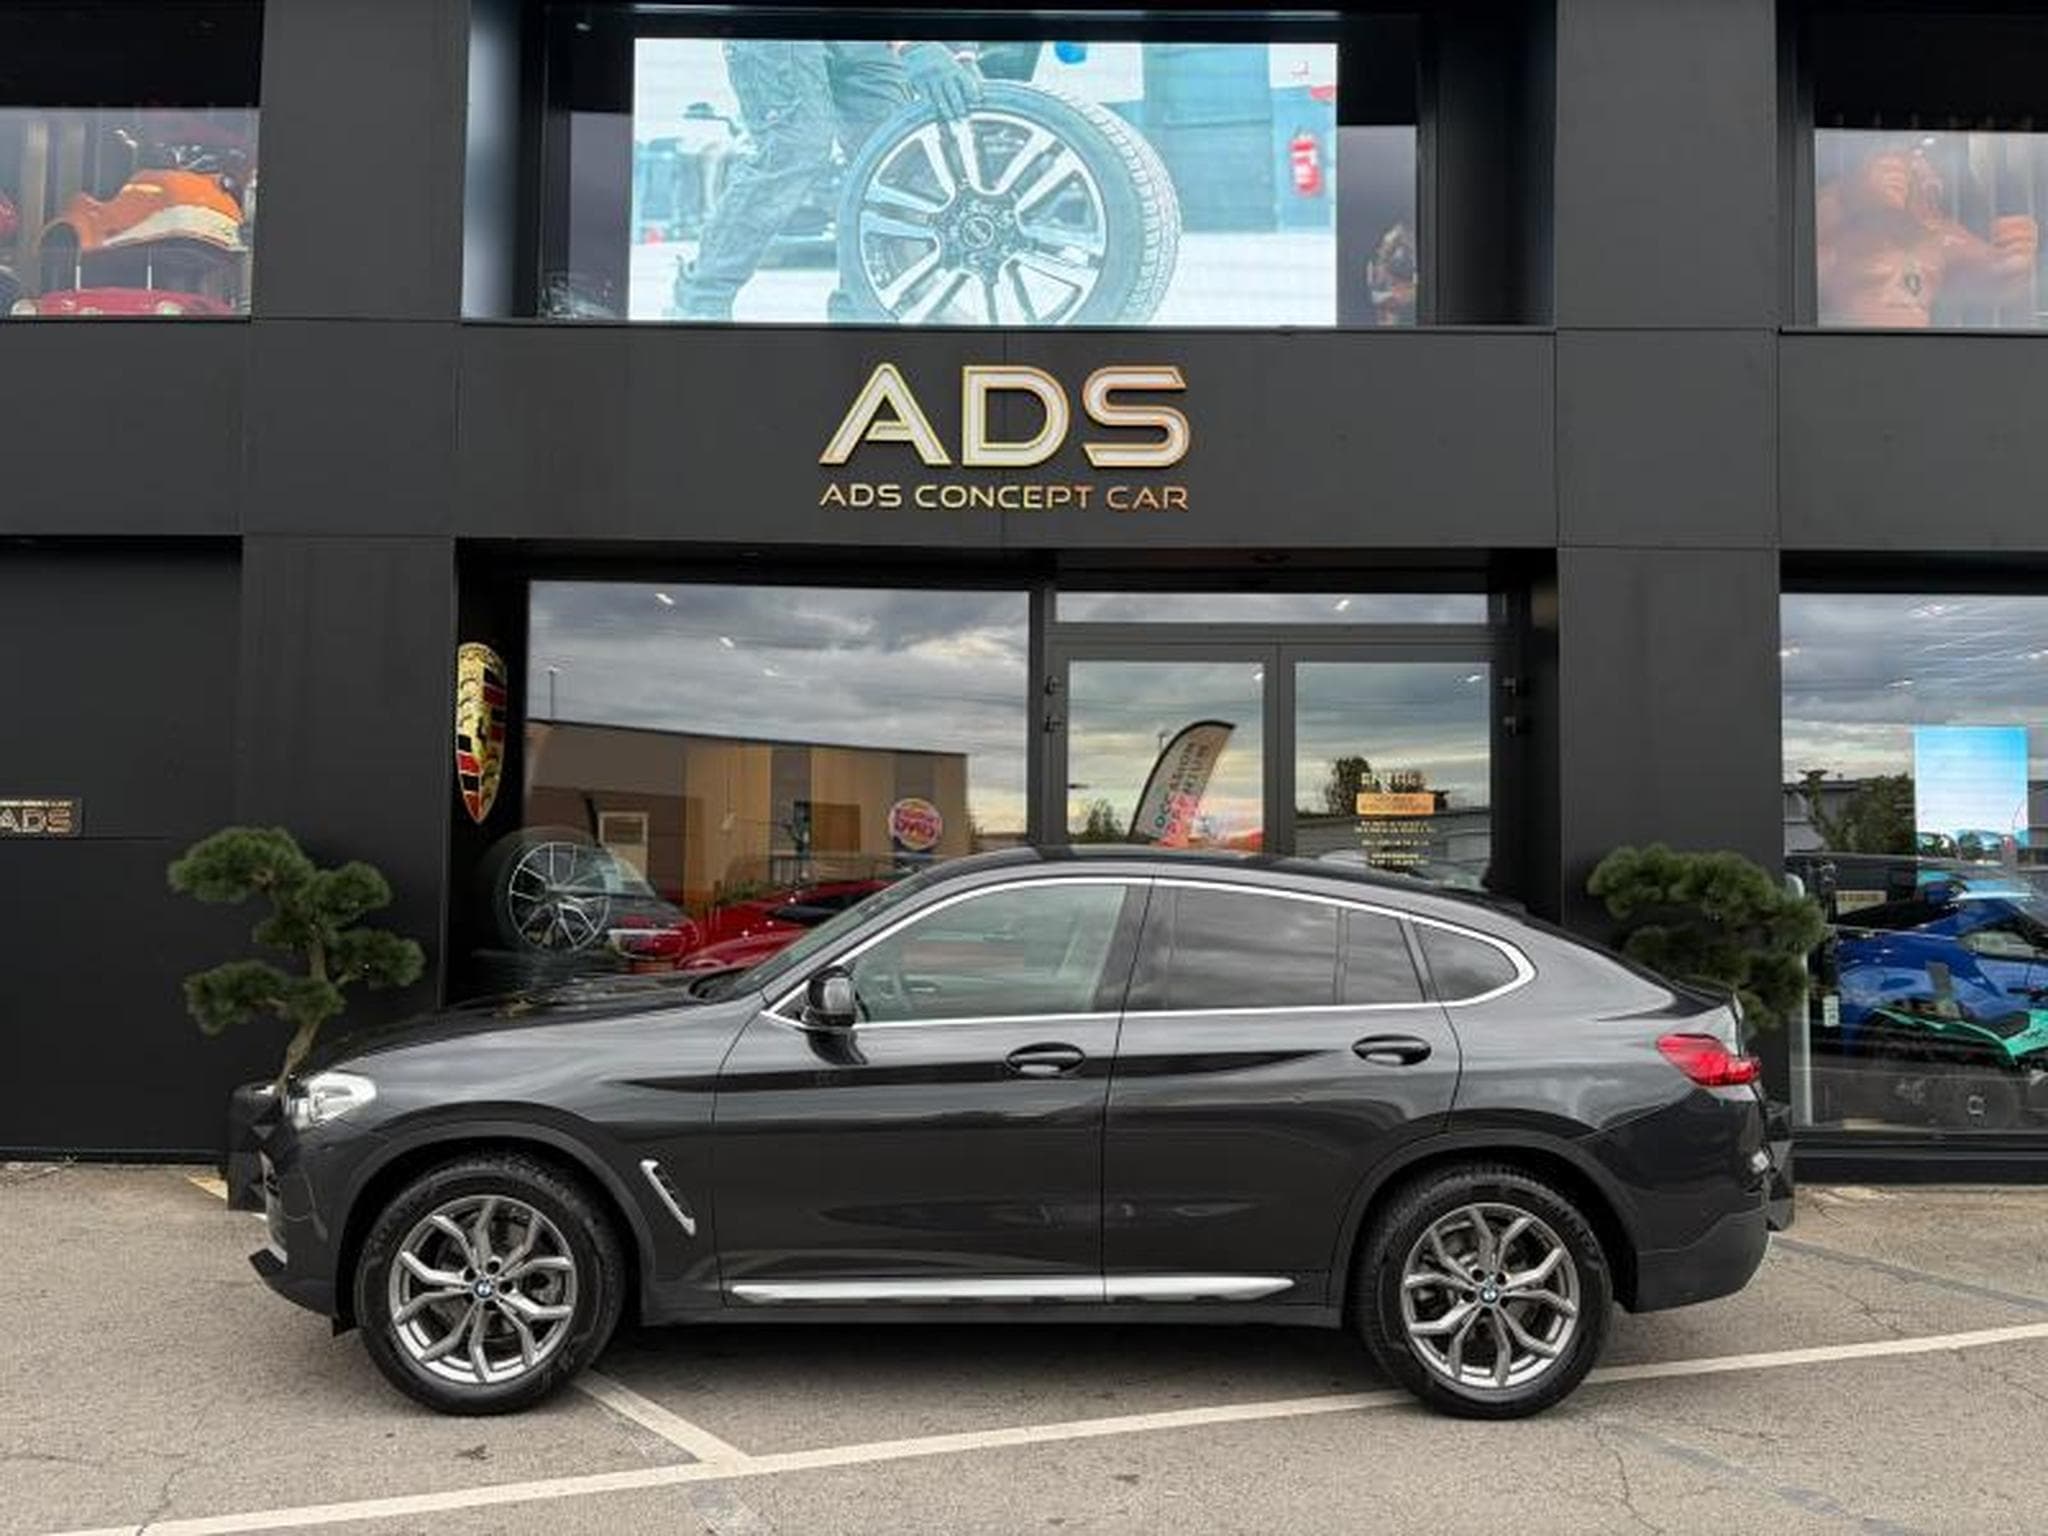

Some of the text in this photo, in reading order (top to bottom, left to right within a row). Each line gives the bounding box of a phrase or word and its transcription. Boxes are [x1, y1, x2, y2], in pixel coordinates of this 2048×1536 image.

[818, 362, 1191, 467] ADS
[819, 483, 1190, 510] ADS CONCEPT CAR
[0, 808, 72, 833] ADS
